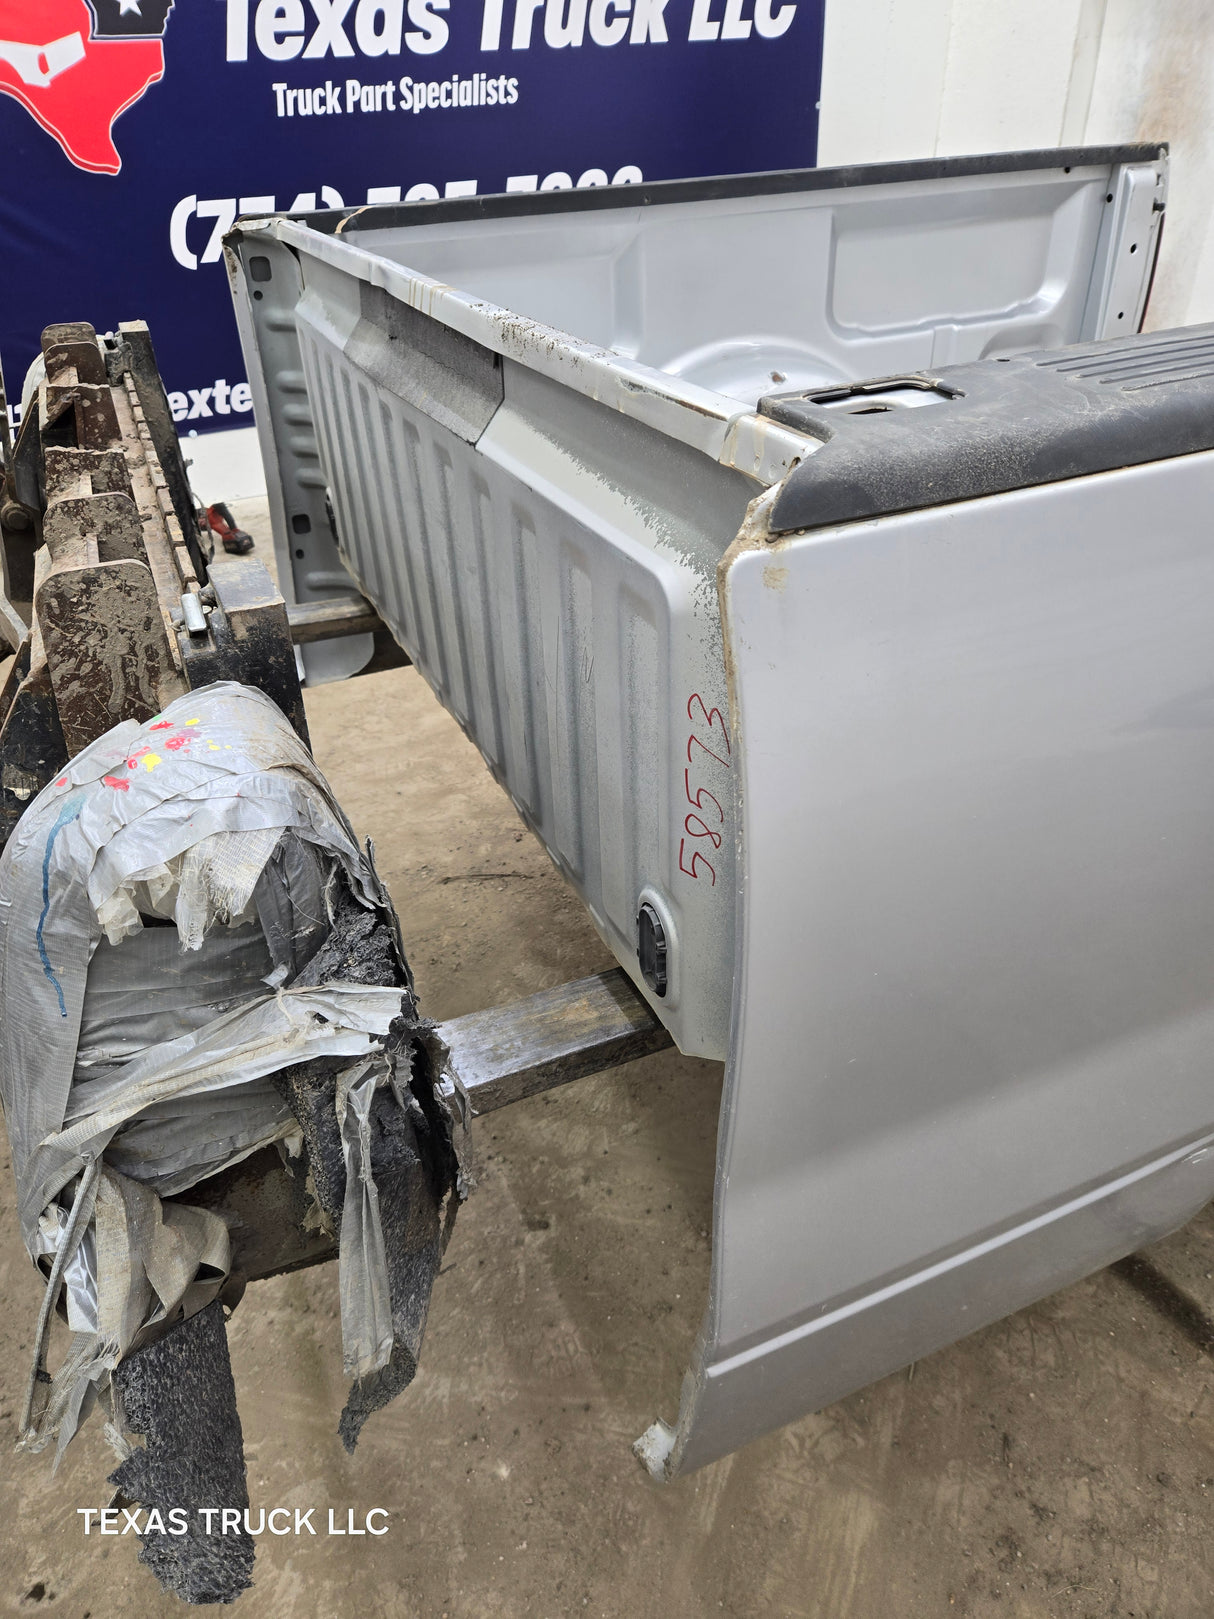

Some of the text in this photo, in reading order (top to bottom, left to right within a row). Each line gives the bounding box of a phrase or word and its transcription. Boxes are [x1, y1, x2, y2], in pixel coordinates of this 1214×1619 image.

[226, 0, 798, 62] Texas Truck LLC
[272, 72, 520, 117] Truck Part Specialists
[679, 693, 730, 886] 58573
